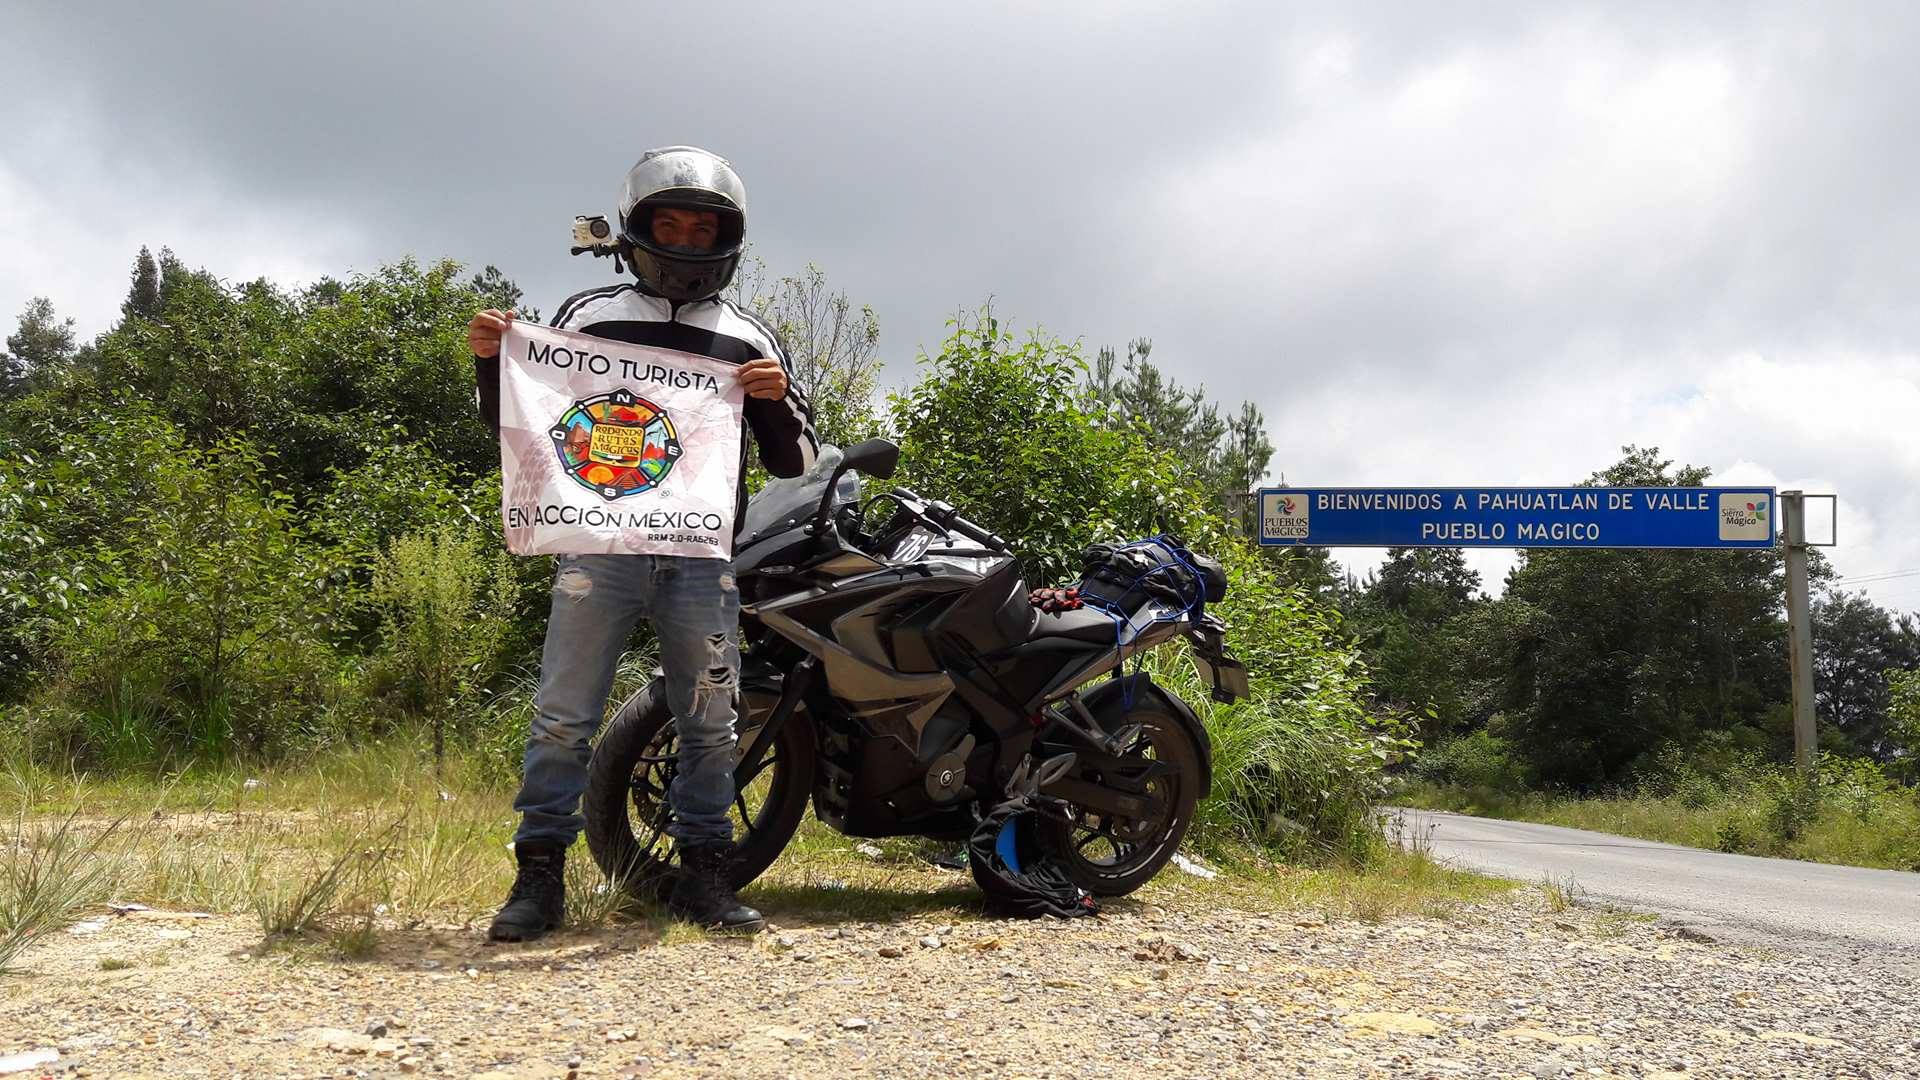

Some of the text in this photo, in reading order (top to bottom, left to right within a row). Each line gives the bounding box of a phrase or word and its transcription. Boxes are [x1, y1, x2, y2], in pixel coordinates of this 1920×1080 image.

[527, 341, 719, 394] MOTO TURISTA
[616, 394, 631, 403] N
[668, 446, 679, 456] E
[604, 487, 617, 497] S
[1317, 493, 1710, 510] BIENVENIDOS A PAHUATLAN DE VALLE
[508, 504, 722, 531] EN ACCIÓN MÉXICO
[1721, 508, 1744, 517] Sierra
[1422, 523, 1600, 540] PUEBLO MAGICO
